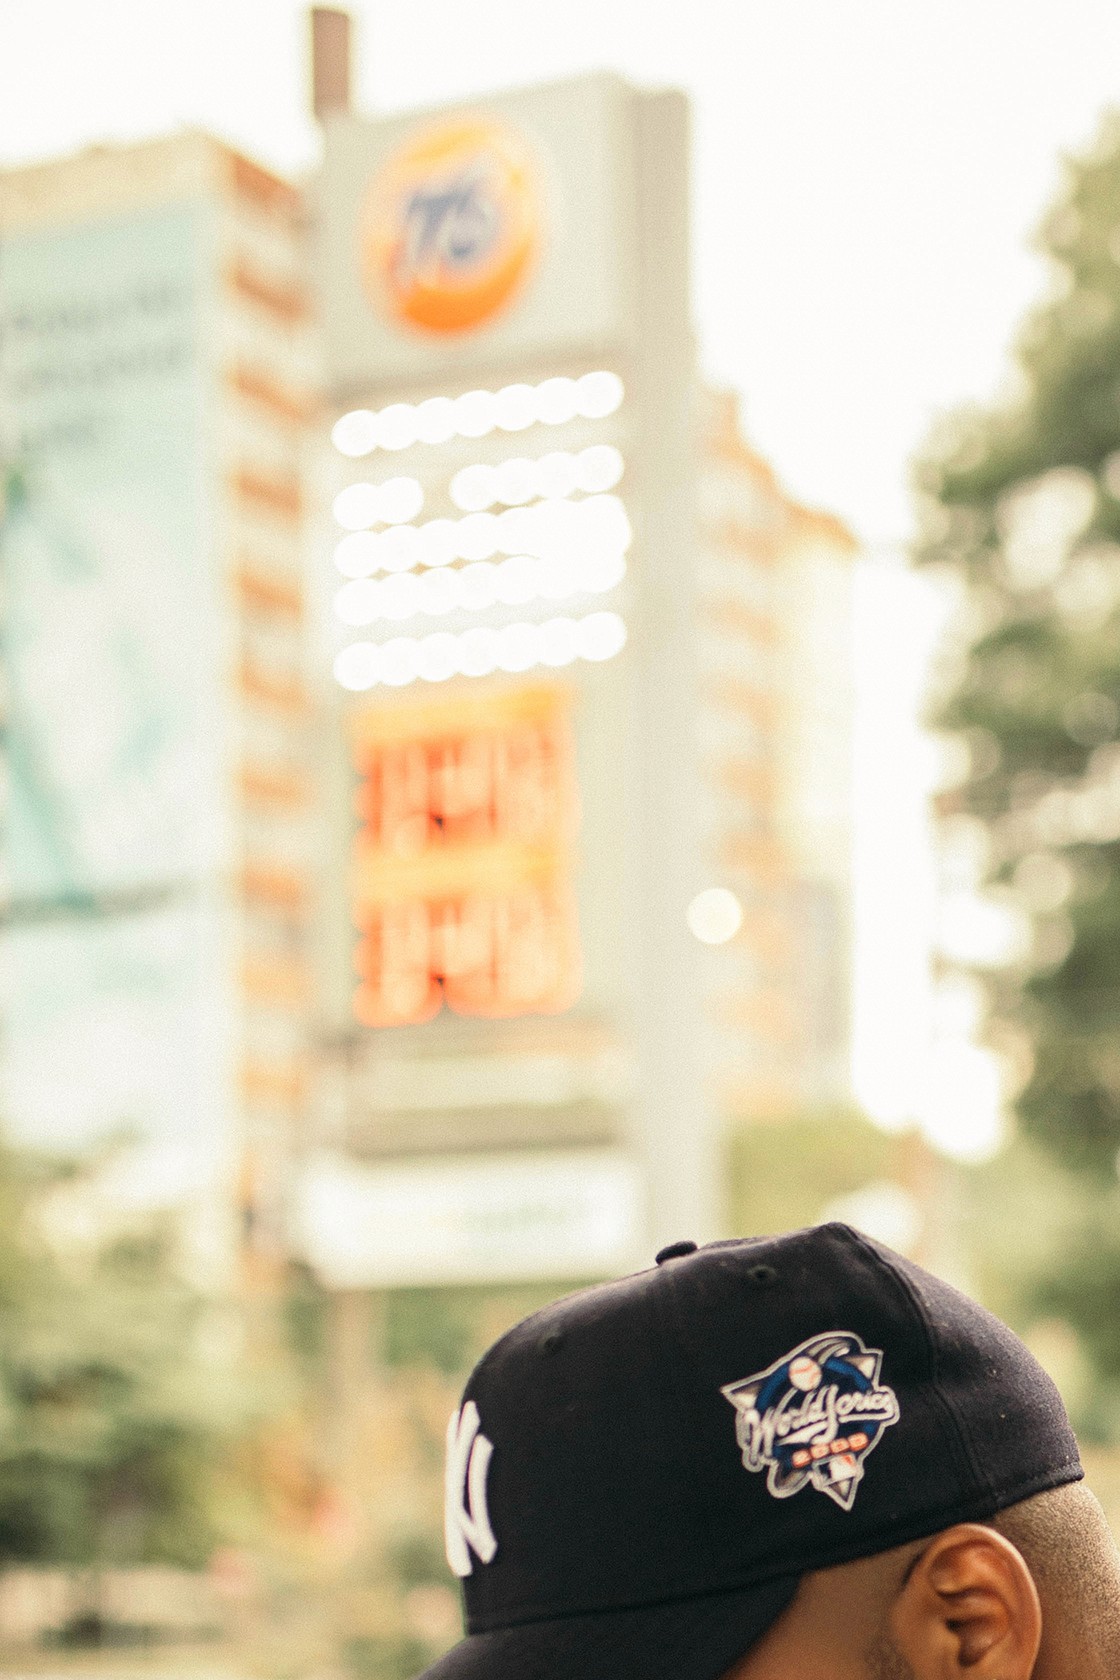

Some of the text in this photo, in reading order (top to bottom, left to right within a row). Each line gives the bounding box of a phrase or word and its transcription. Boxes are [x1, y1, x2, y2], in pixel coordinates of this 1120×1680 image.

[743, 1383, 896, 1466] World Series
[791, 1431, 869, 1469] 2000
